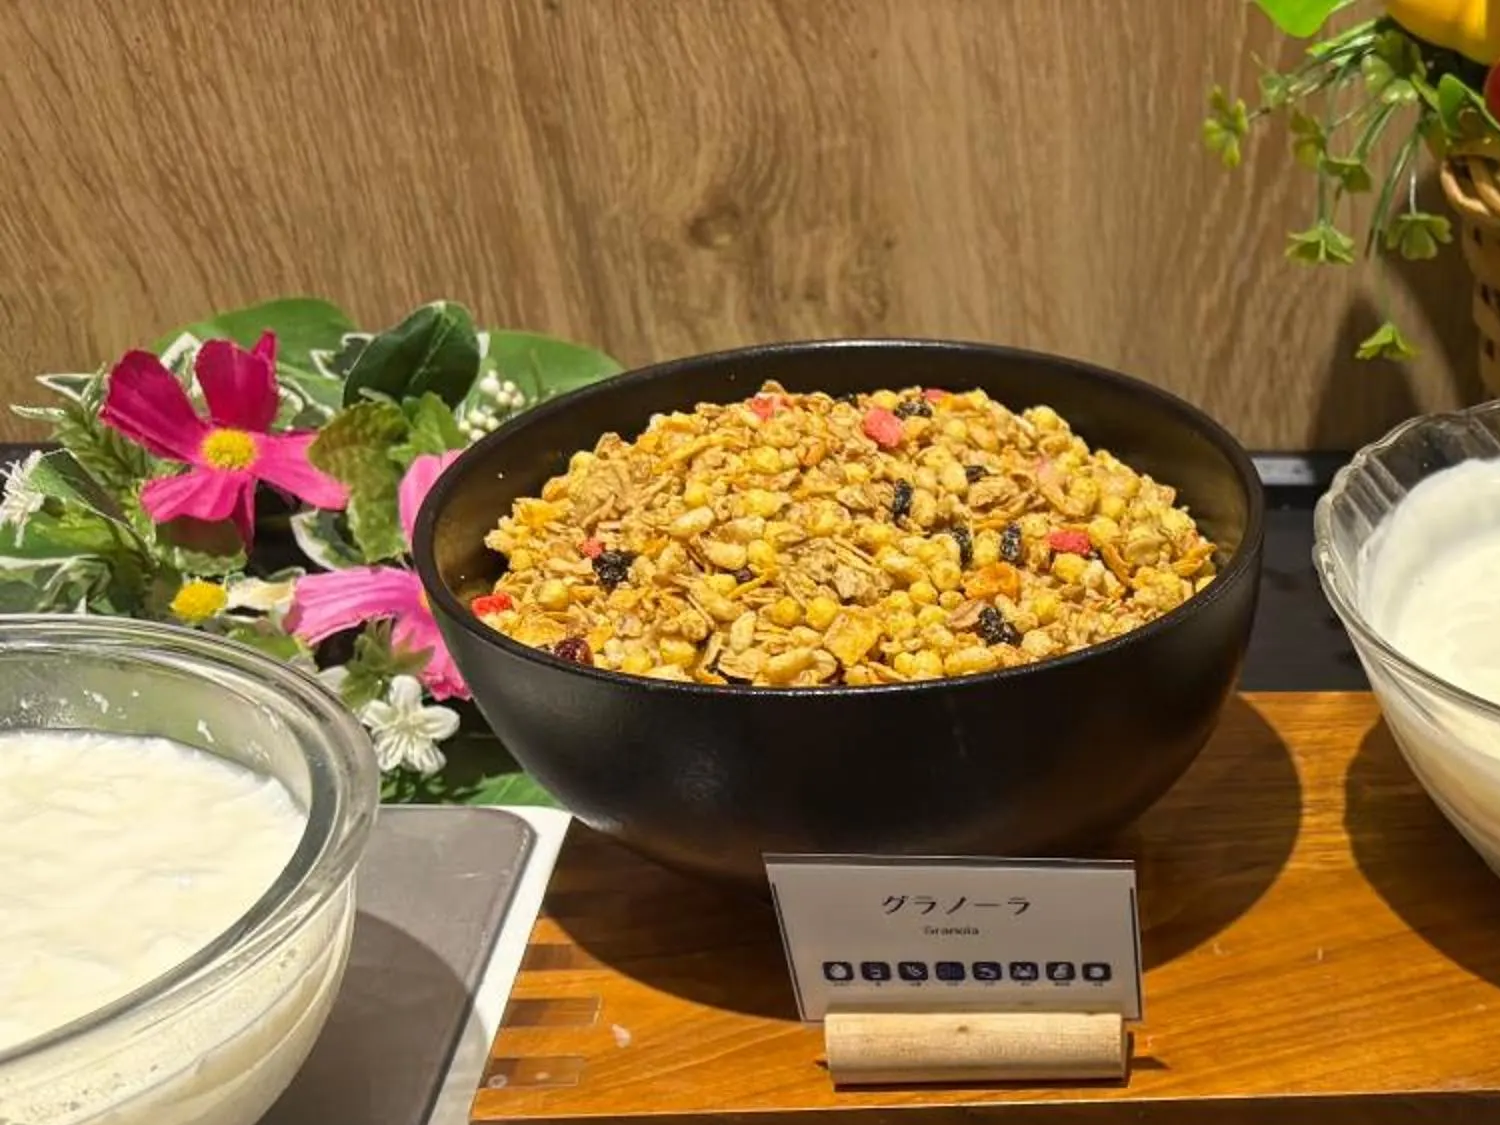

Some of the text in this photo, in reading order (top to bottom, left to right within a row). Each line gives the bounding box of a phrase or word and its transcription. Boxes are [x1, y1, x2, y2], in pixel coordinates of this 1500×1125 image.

[881, 895, 1032, 916] グラノーラ
